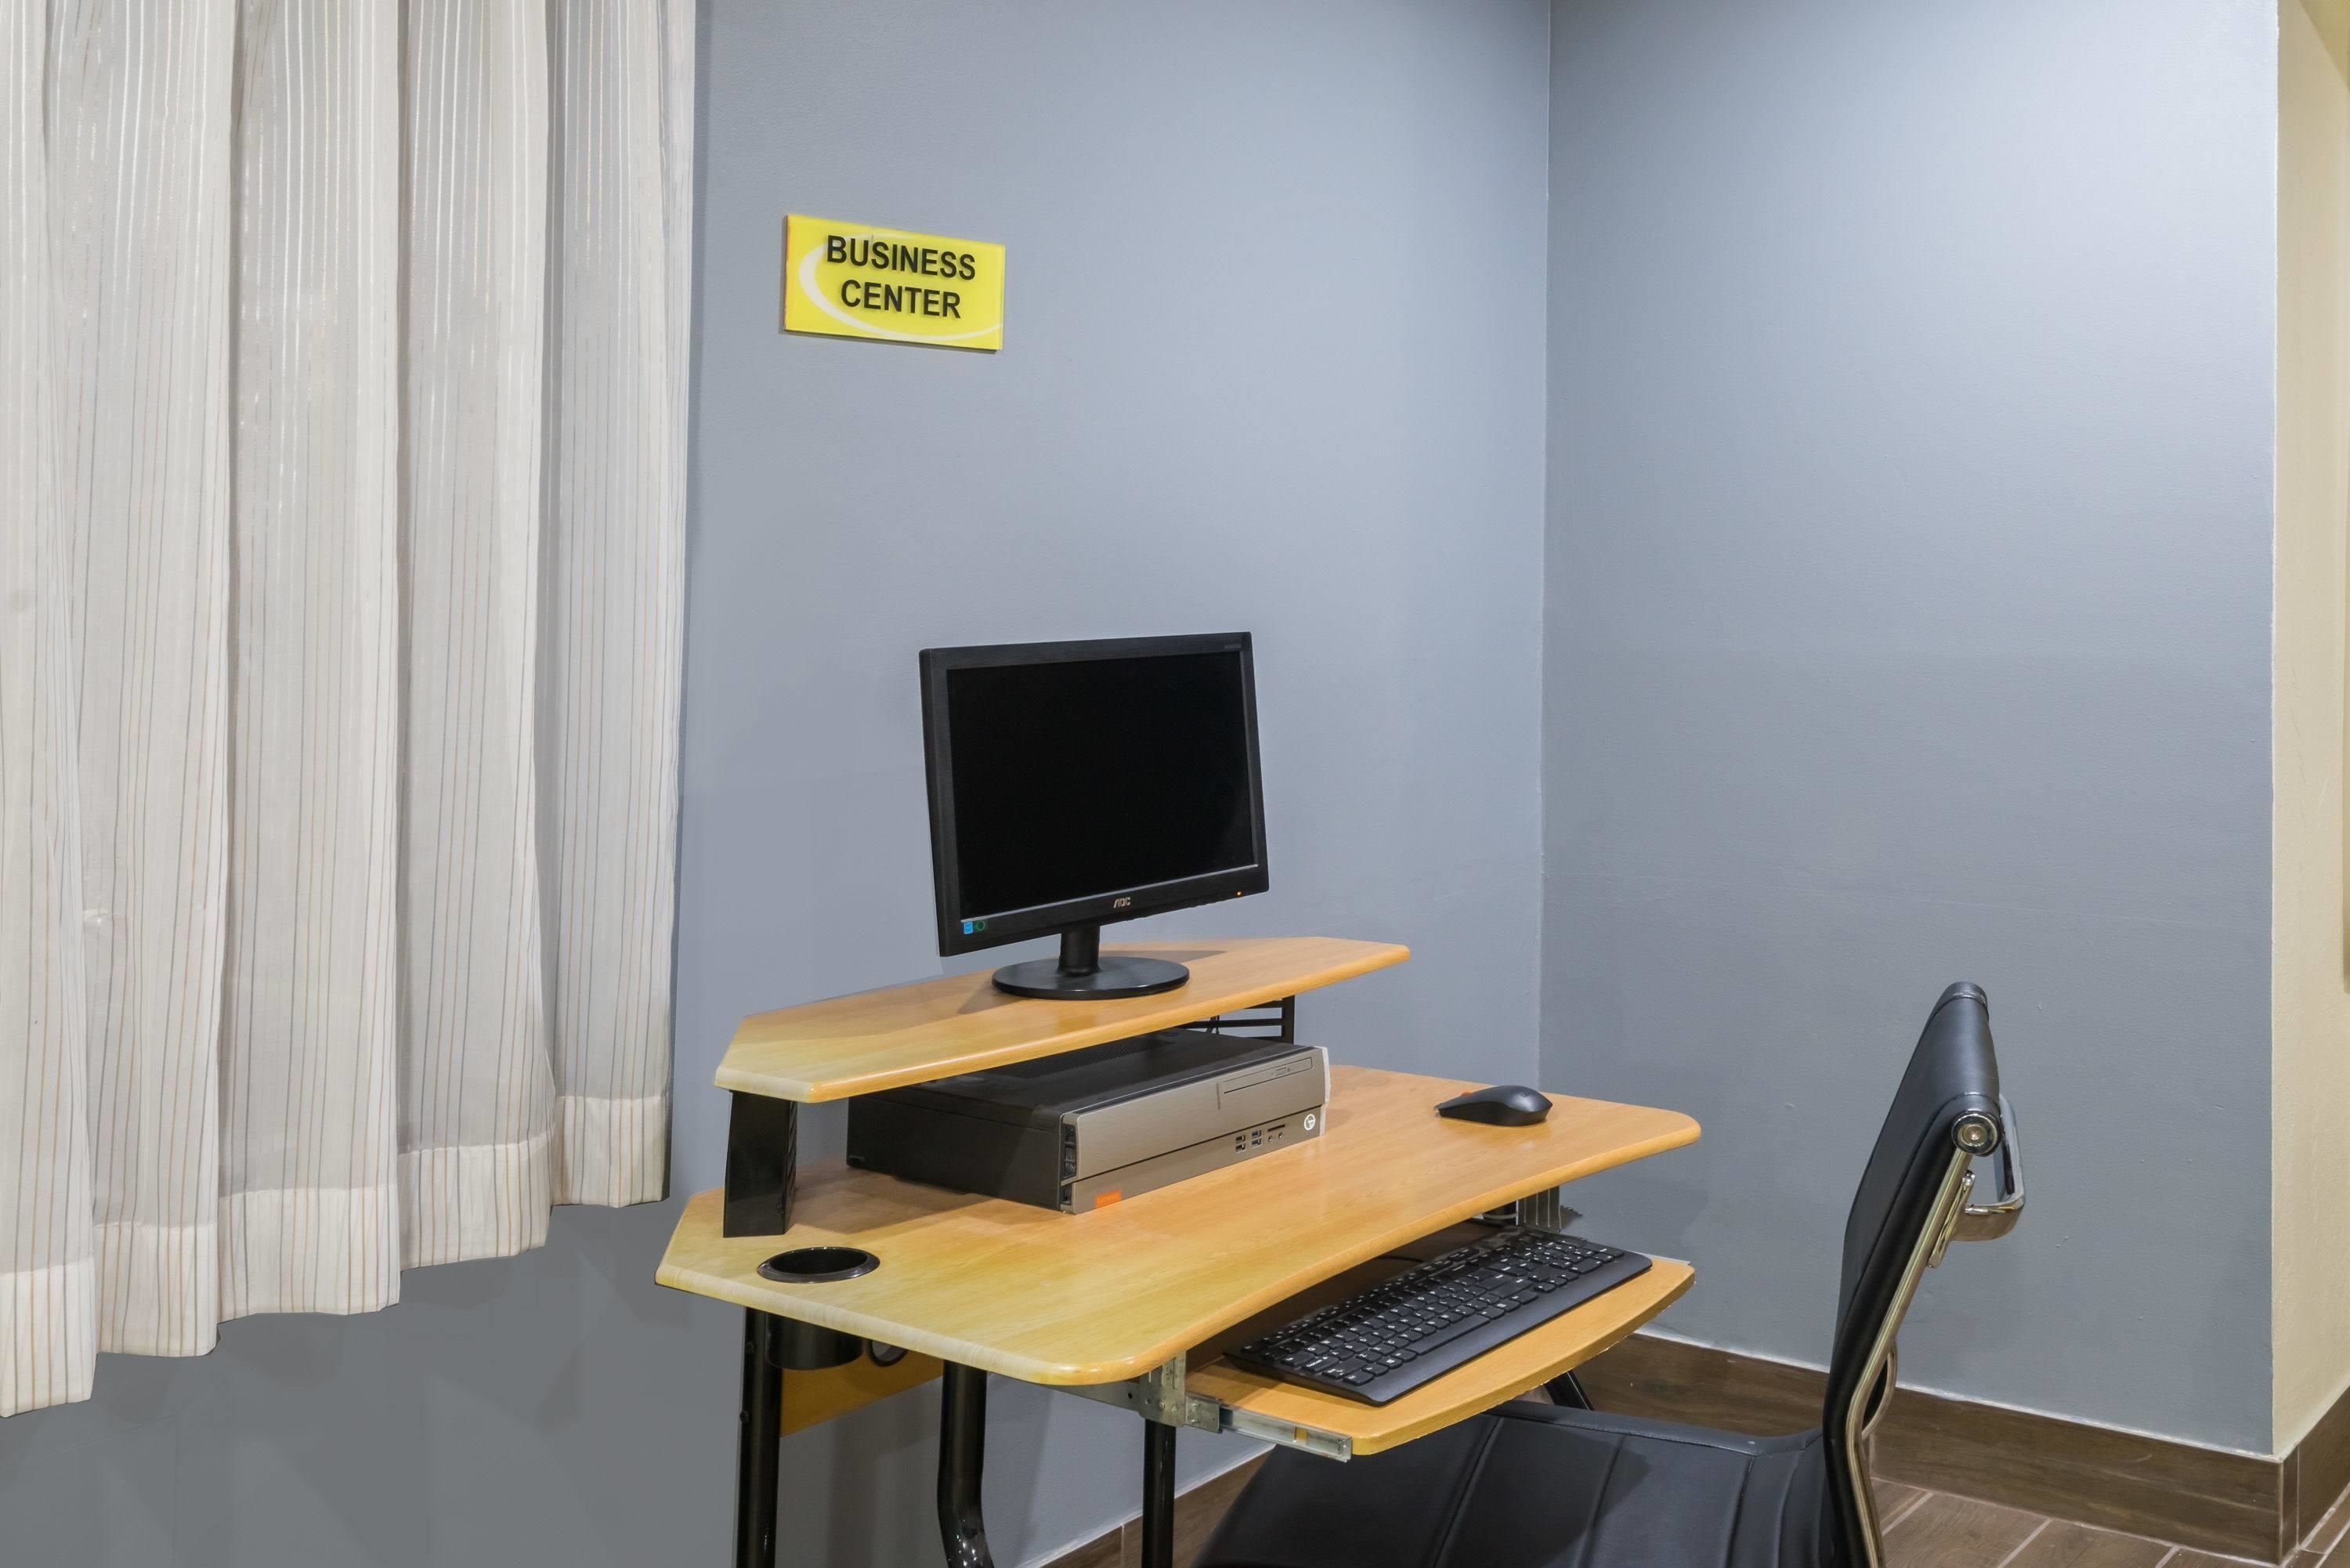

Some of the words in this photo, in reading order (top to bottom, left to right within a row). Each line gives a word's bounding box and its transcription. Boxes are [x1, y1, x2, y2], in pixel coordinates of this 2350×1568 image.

[826, 235, 976, 280] BUSINESS
[841, 279, 961, 319] CENTER
[1113, 897, 1131, 909] AOC
